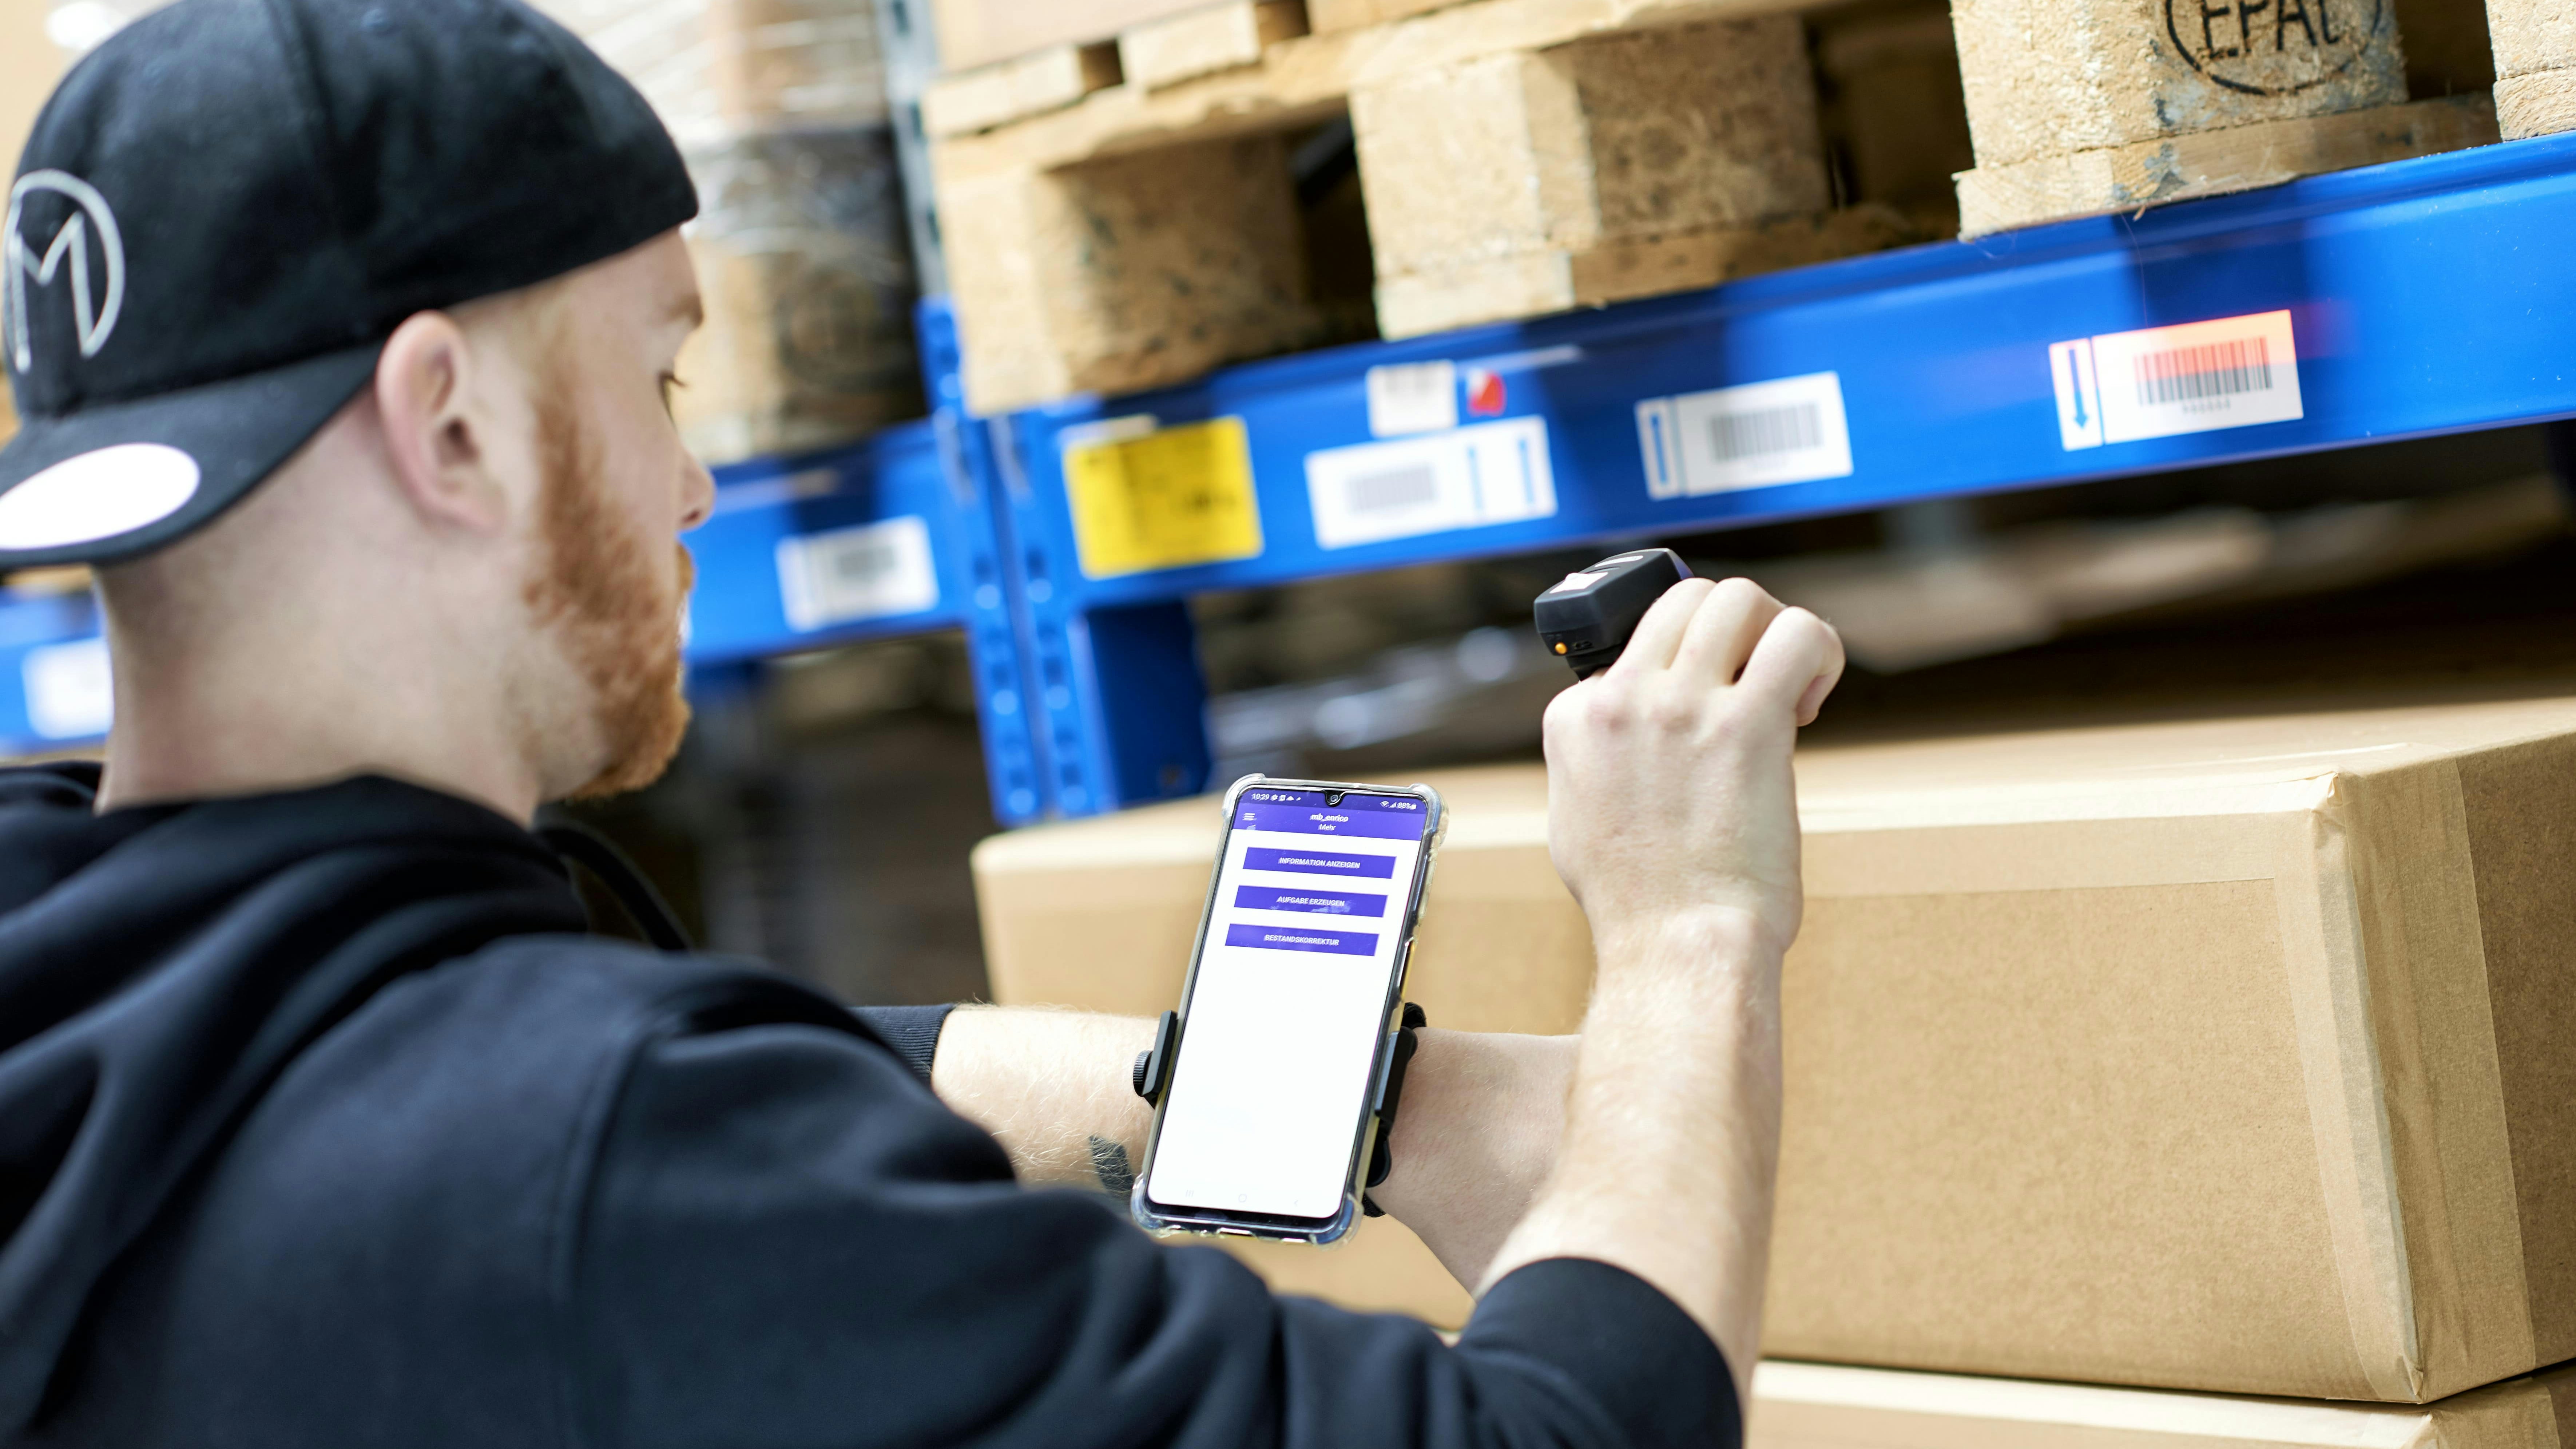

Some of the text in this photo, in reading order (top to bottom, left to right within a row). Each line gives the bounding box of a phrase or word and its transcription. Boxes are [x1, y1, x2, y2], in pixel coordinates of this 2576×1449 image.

[1310, 813, 1349, 822] mb_enrico
[1278, 857, 1361, 868] INFORMATION ANZEIGEN
[1276, 896, 1345, 906] AUFGABE ERZEUGEN
[1264, 934, 1339, 946] BESTANDSKORREKTUR
